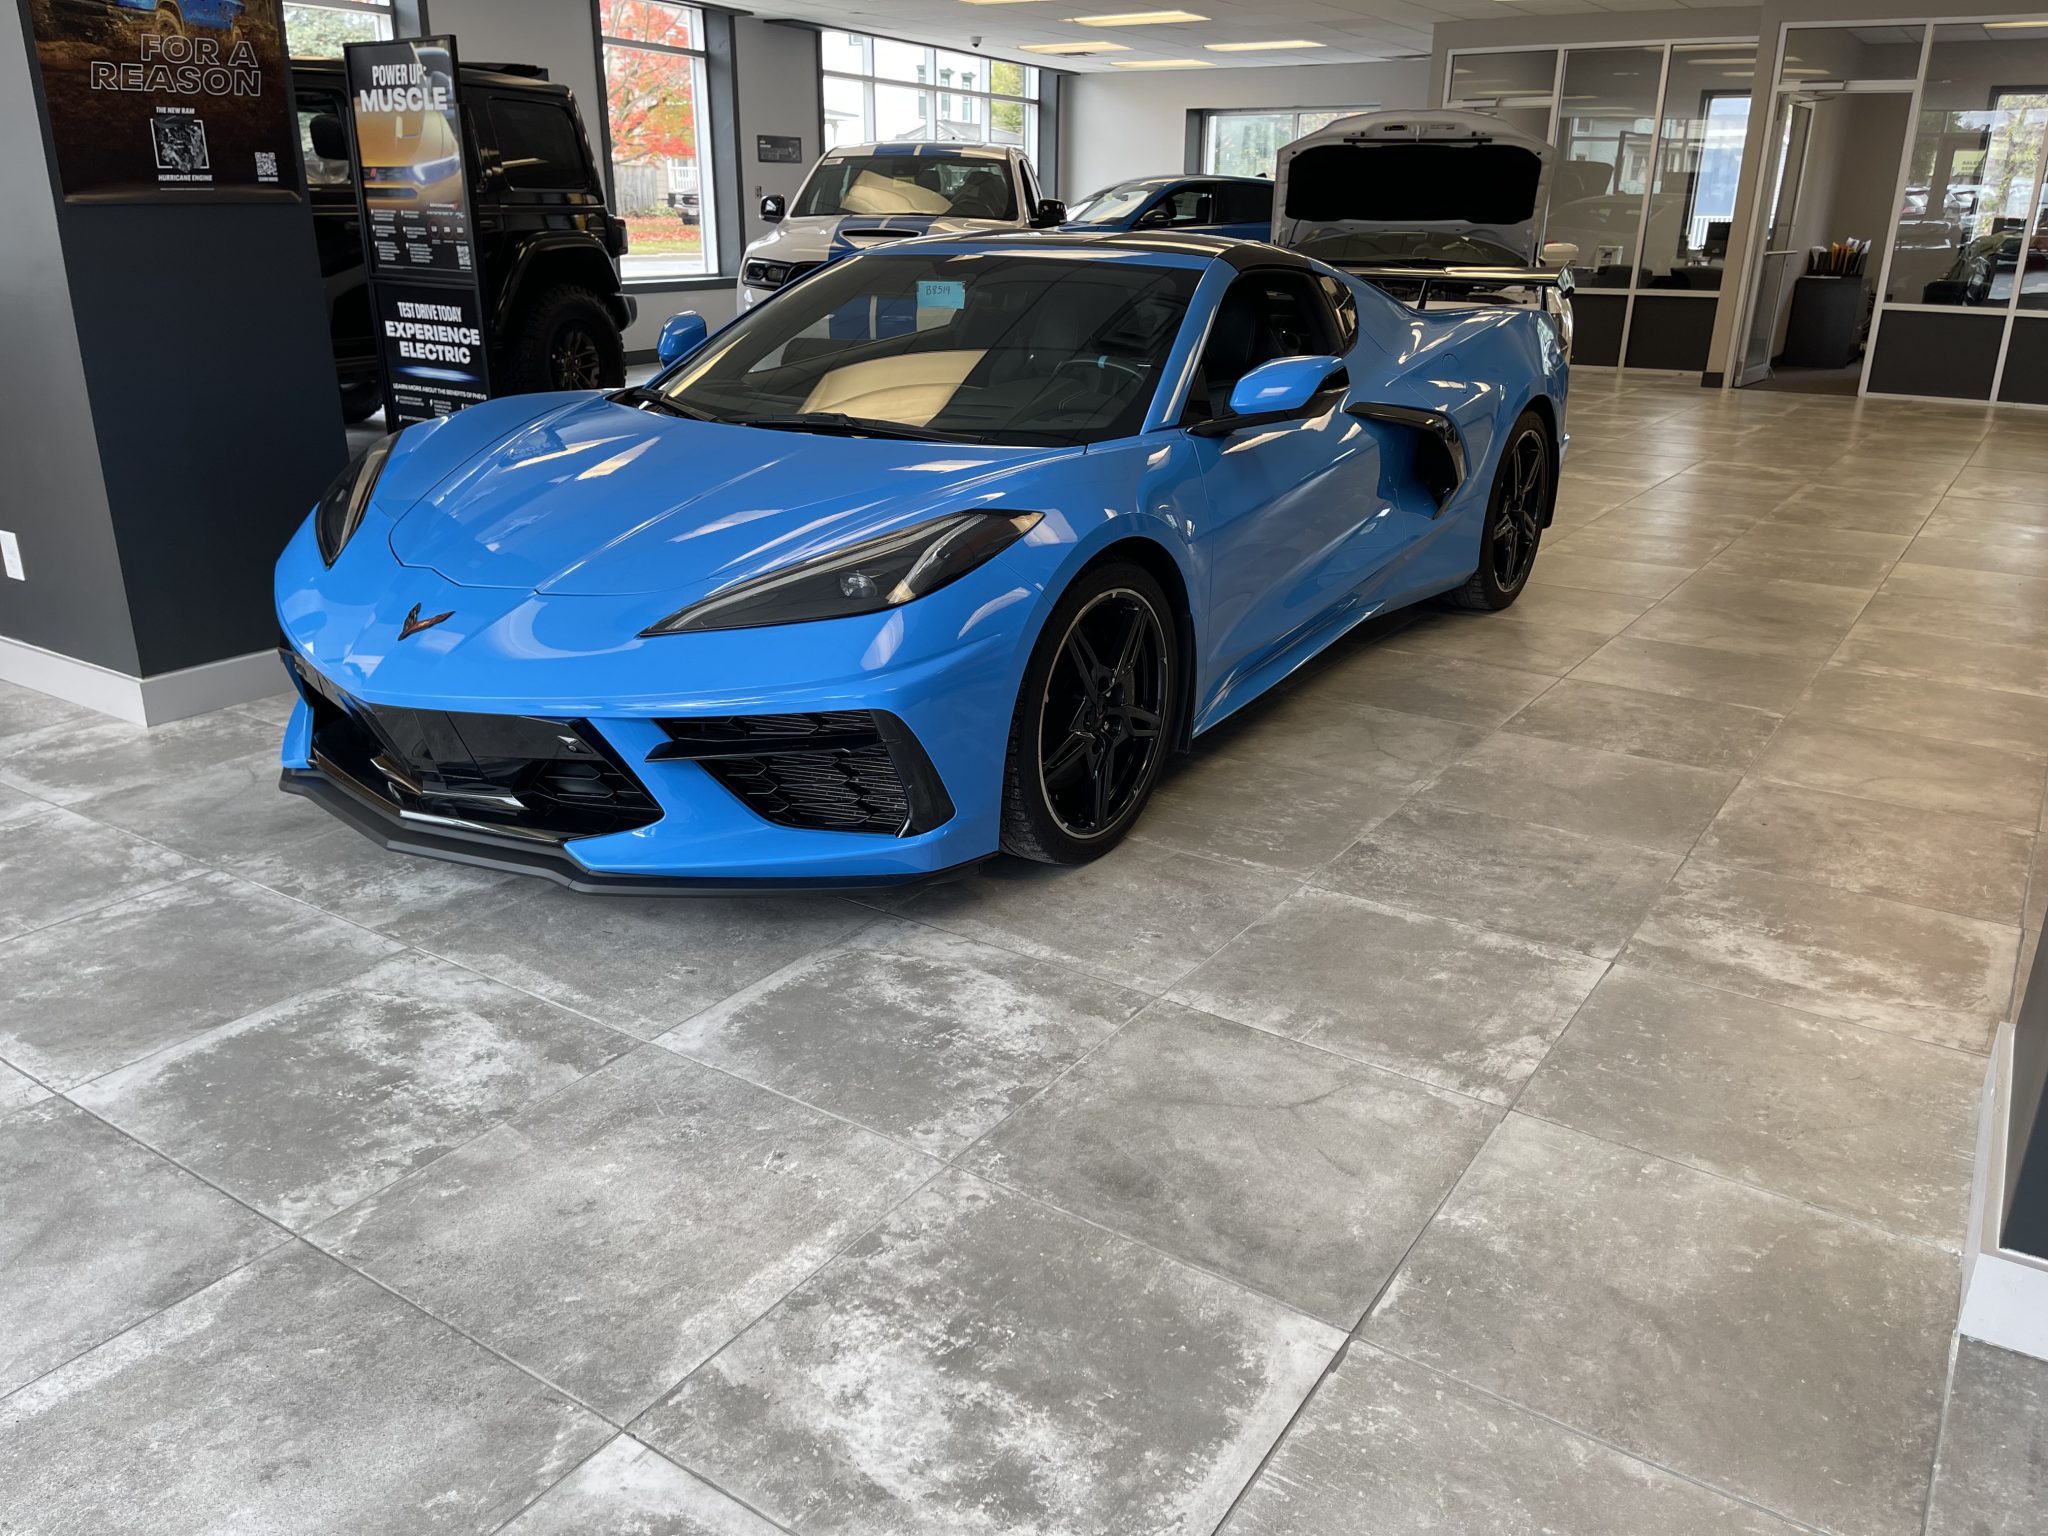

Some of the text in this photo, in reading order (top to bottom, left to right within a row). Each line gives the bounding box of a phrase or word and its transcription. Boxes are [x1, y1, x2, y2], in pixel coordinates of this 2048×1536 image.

[141, 34, 258, 67] FOR A
[91, 61, 261, 97] REASON
[371, 63, 427, 87] POWER UP:
[156, 106, 195, 115] THE NEW RAM
[360, 87, 448, 113] MUSCLE
[158, 174, 213, 182] HURRICANE ENGINE
[397, 302, 462, 322] TEST DRIVE TODAY
[385, 320, 480, 346] EXPERIENCE
[399, 340, 471, 364] ELECTRIC
[408, 384, 421, 392] MORE
[422, 386, 437, 394] ABOUT
[446, 389, 466, 398] BENEFITS
